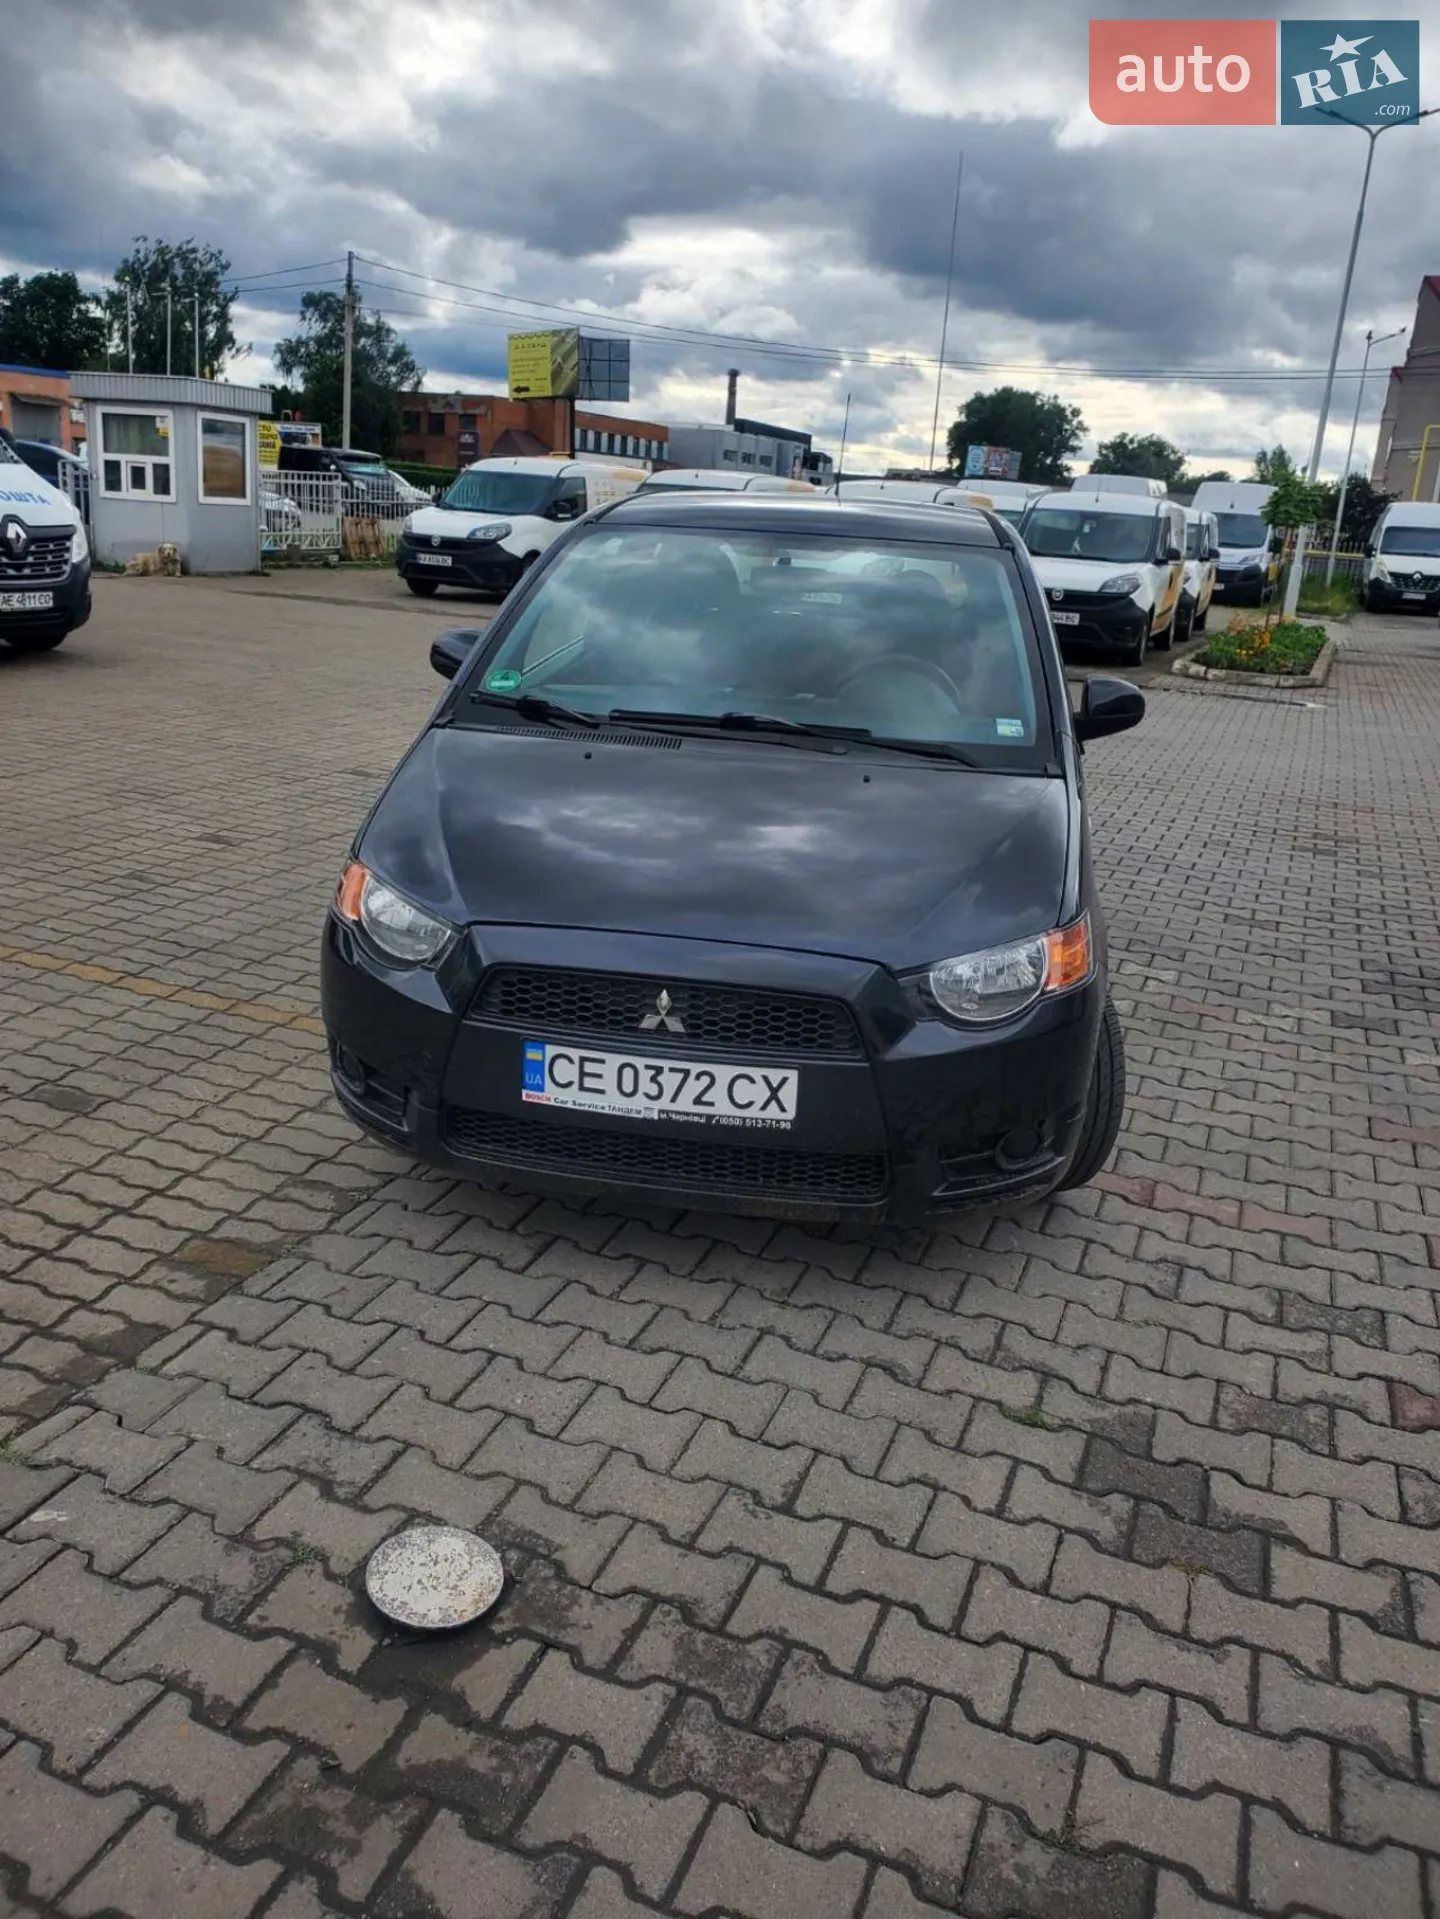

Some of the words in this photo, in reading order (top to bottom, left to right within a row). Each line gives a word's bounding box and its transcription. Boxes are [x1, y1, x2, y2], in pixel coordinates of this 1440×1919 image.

[525, 1072, 543, 1085] UA
[548, 1053, 606, 1095] CE
[616, 1061, 717, 1107] 0372
[727, 1073, 790, 1113] CX
[524, 1092, 551, 1103] BOSCH
[553, 1097, 569, 1106] Car
[571, 1099, 606, 1111] Service
[719, 1115, 743, 1126] (050)
